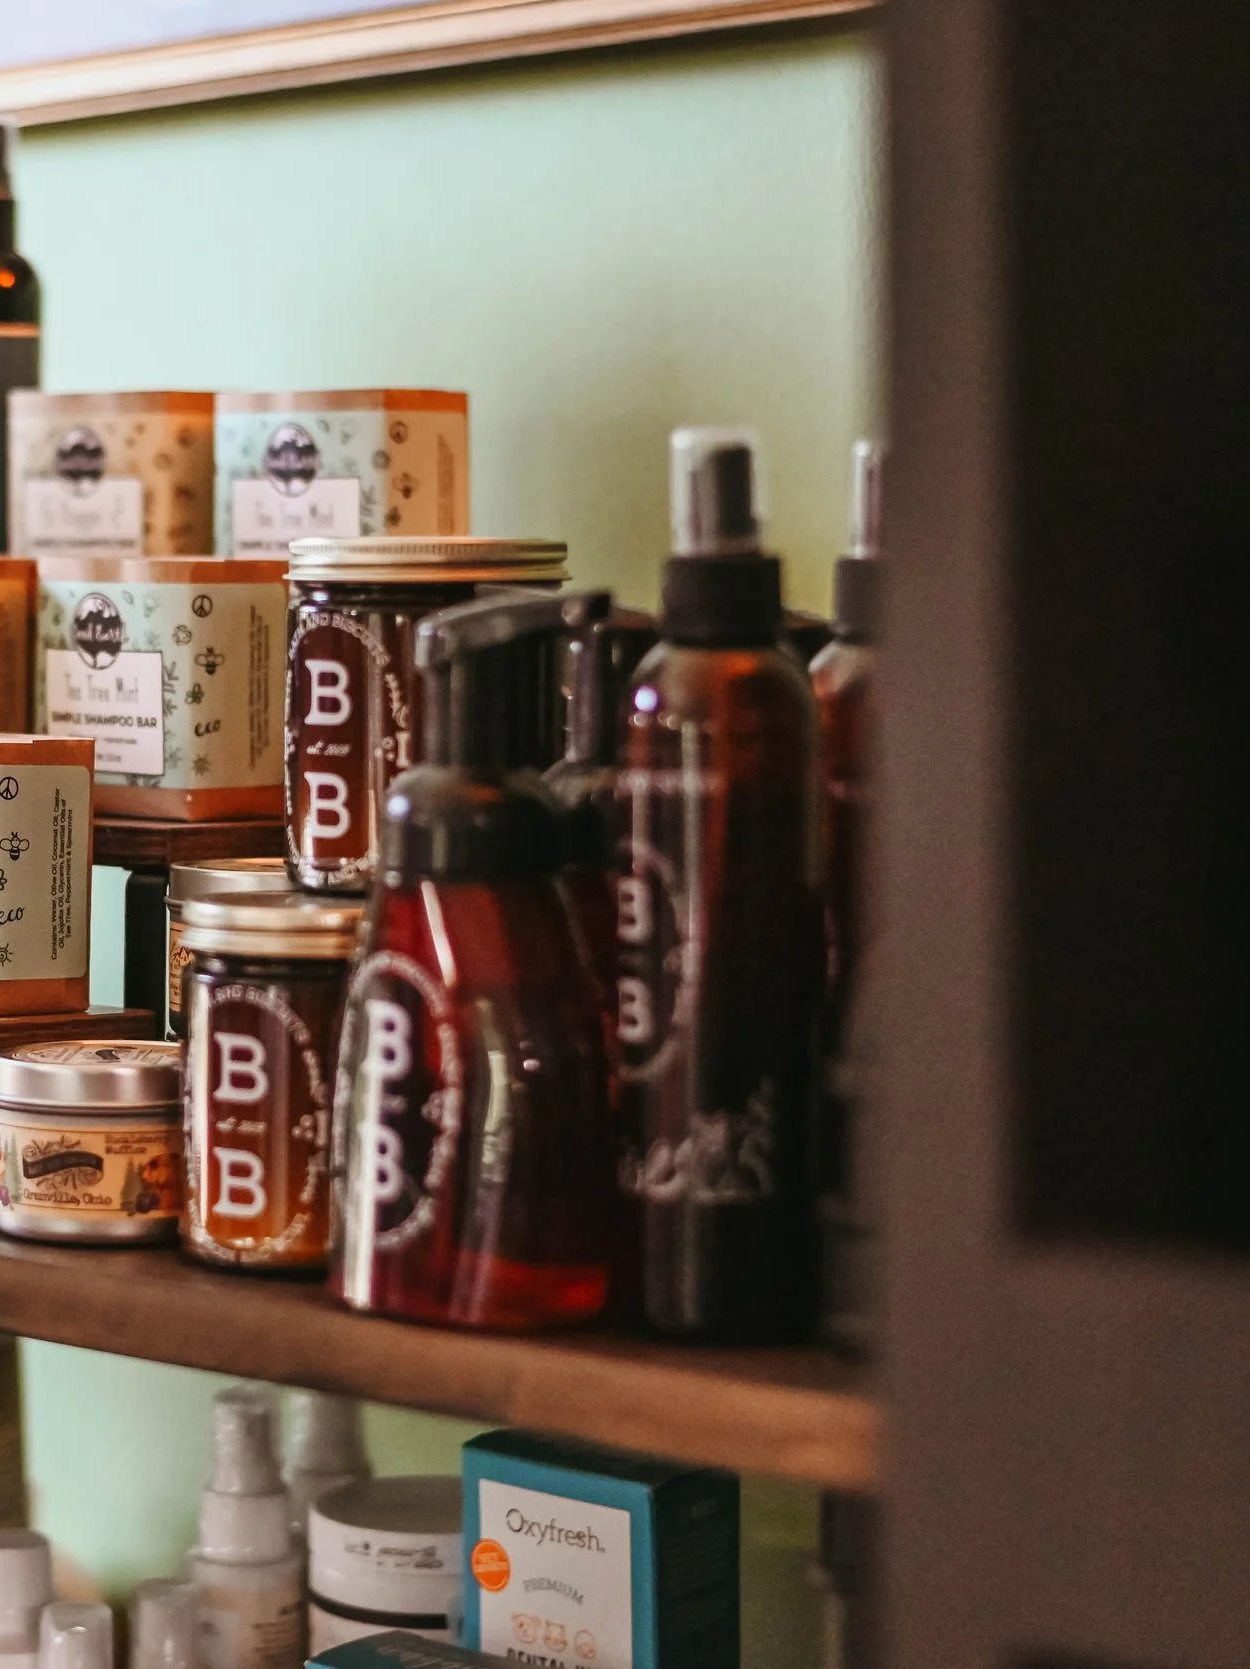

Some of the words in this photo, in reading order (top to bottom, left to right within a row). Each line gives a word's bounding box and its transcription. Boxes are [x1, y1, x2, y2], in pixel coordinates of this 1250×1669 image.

[115, 676, 139, 704] Mint
[304, 659, 351, 726] B
[84, 712, 134, 727] SHAMPOO
[137, 715, 158, 729] BAR
[304, 771, 351, 838] B
[213, 1031, 269, 1103] B
[212, 1146, 268, 1219] B
[505, 1508, 606, 1553] Oxyfresh.
[522, 1577, 585, 1606] PREMIUM
